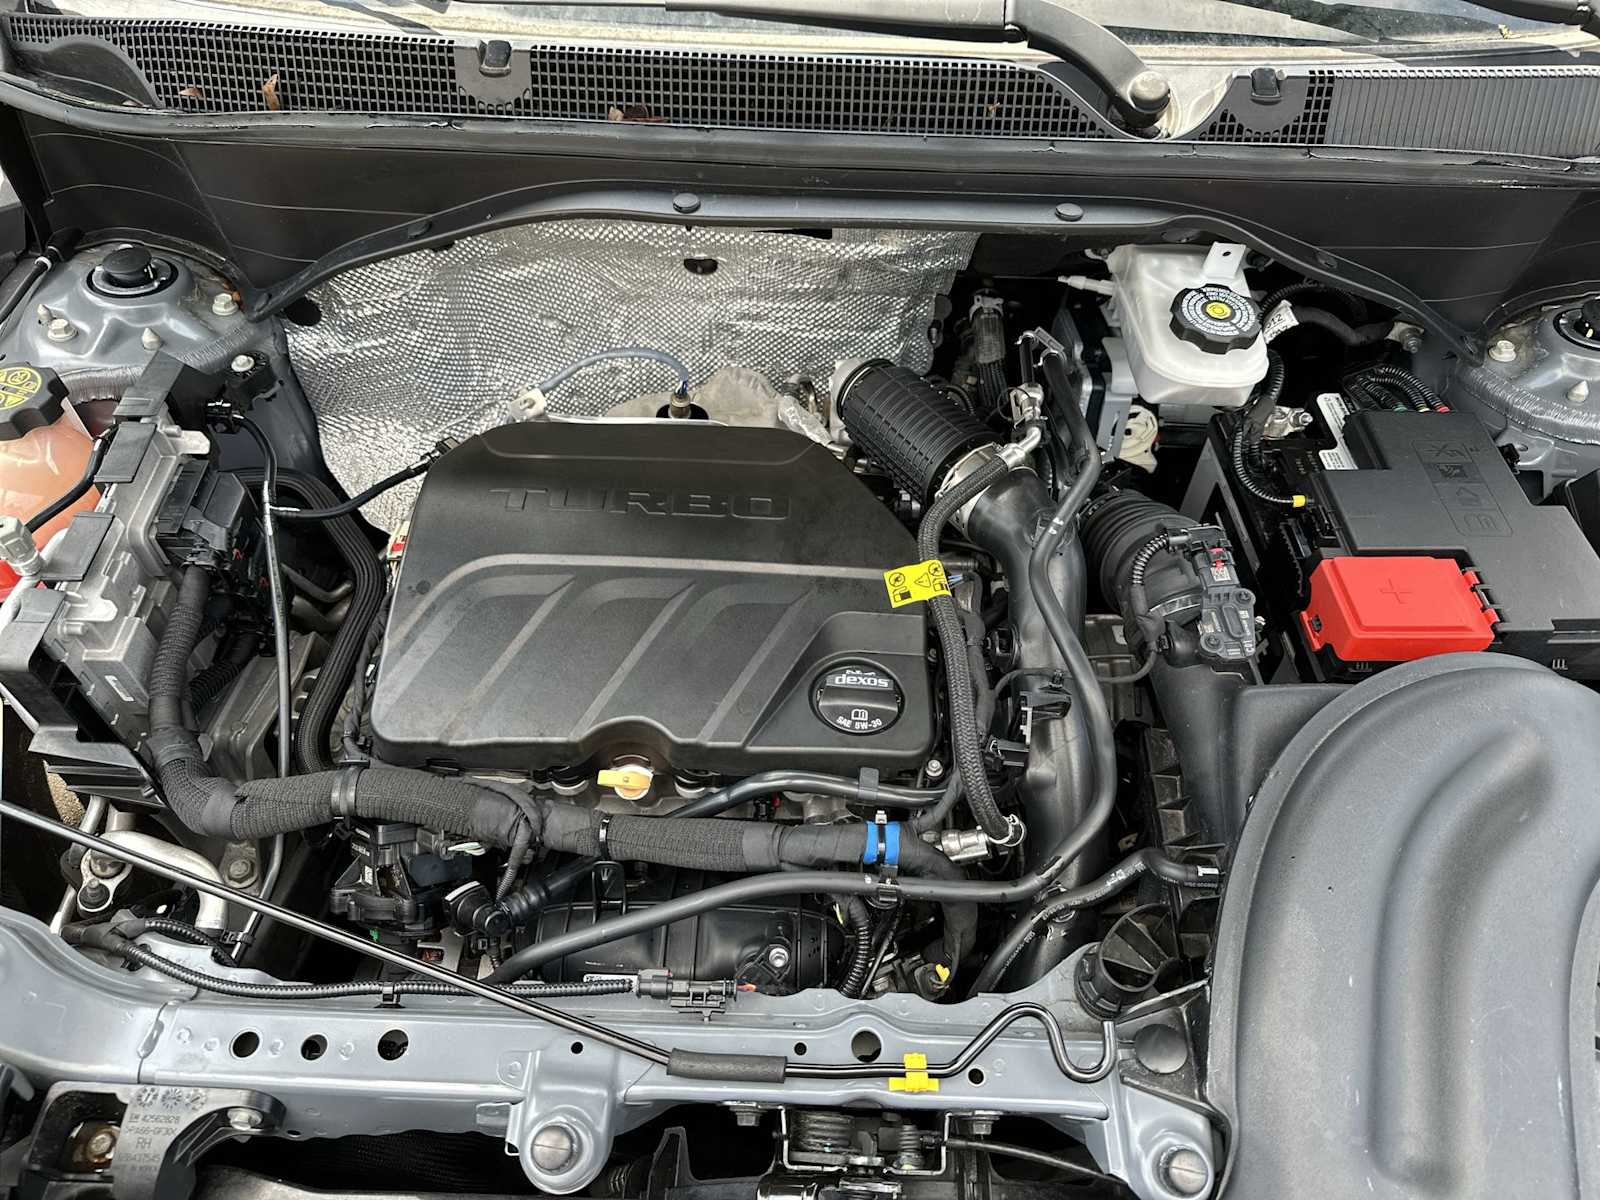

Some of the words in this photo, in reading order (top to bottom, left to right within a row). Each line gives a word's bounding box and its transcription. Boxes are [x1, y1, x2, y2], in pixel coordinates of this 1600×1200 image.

[488, 488, 791, 521] TURBO
[834, 673, 890, 688] dexos
[836, 716, 852, 729] SAE
[854, 718, 883, 730] 5W-30
[135, 1137, 152, 1149] RH
